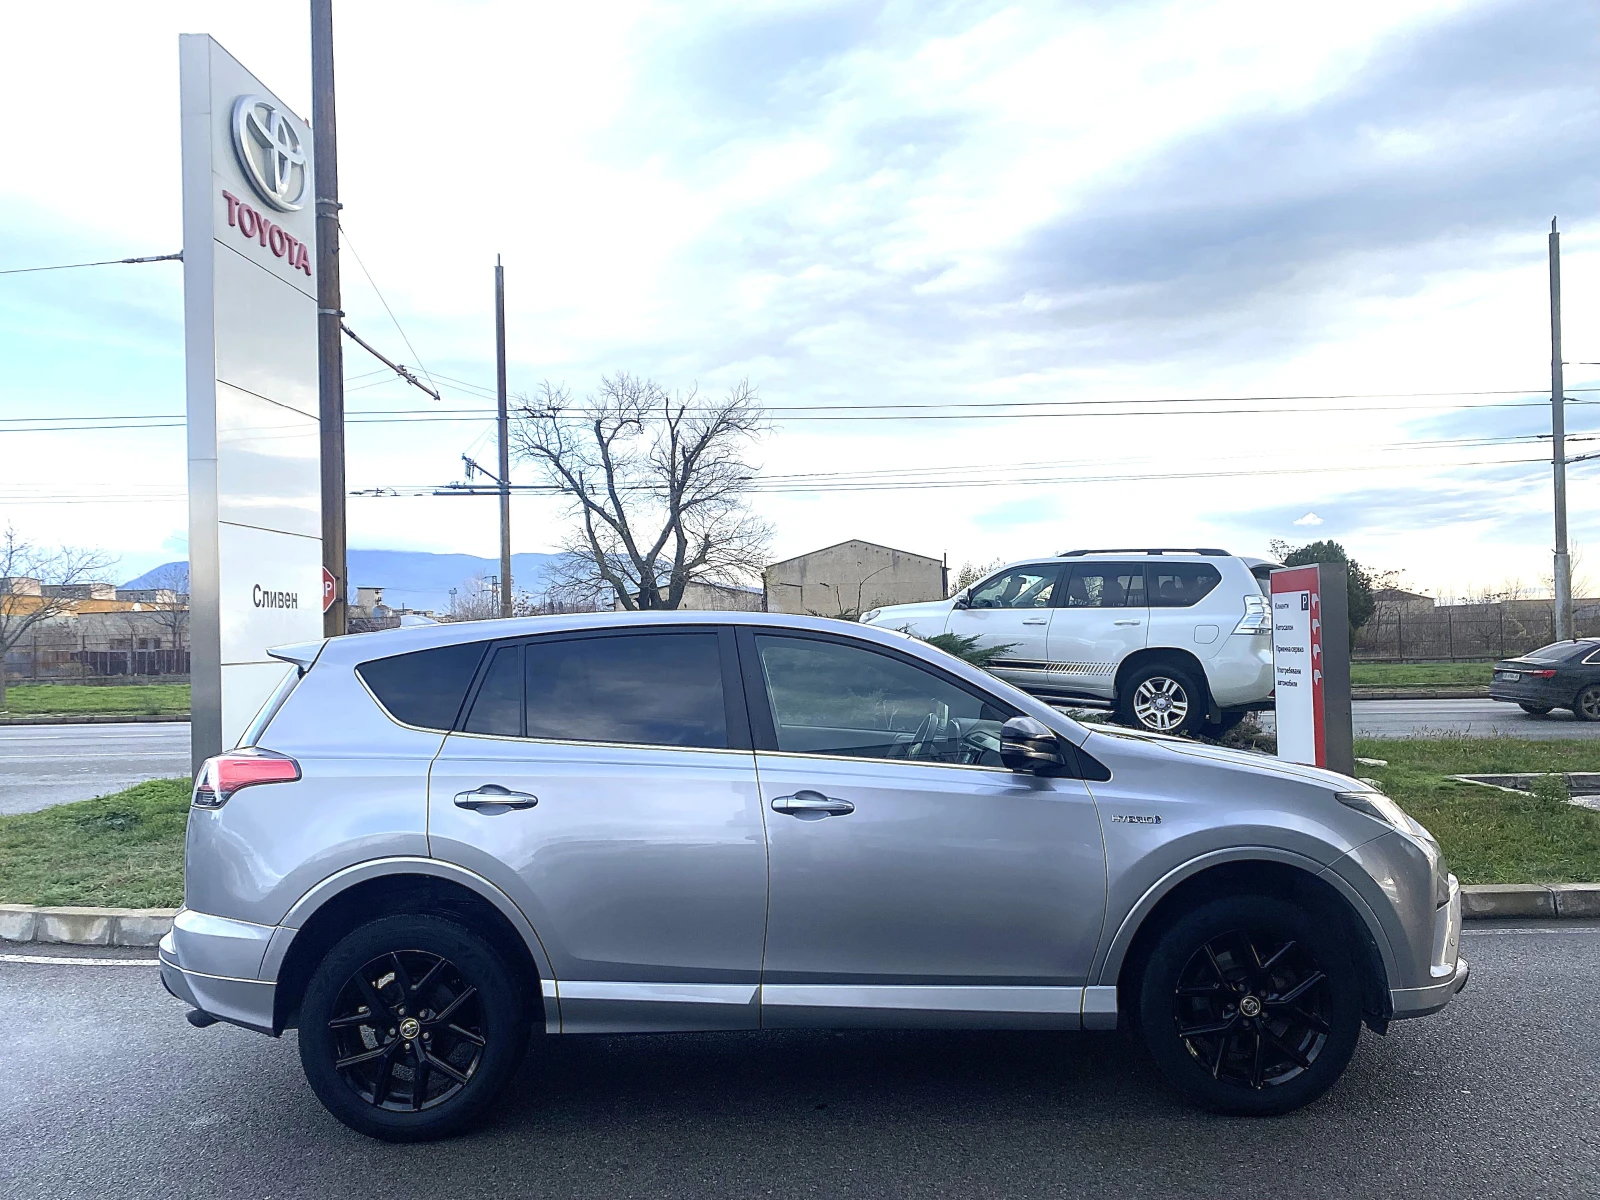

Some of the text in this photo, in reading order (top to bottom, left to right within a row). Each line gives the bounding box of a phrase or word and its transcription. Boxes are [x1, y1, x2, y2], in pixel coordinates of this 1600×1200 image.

[222, 189, 312, 277] TOYOTA
[252, 583, 298, 610] Сливен
[1111, 815, 1154, 824] HYBRID
